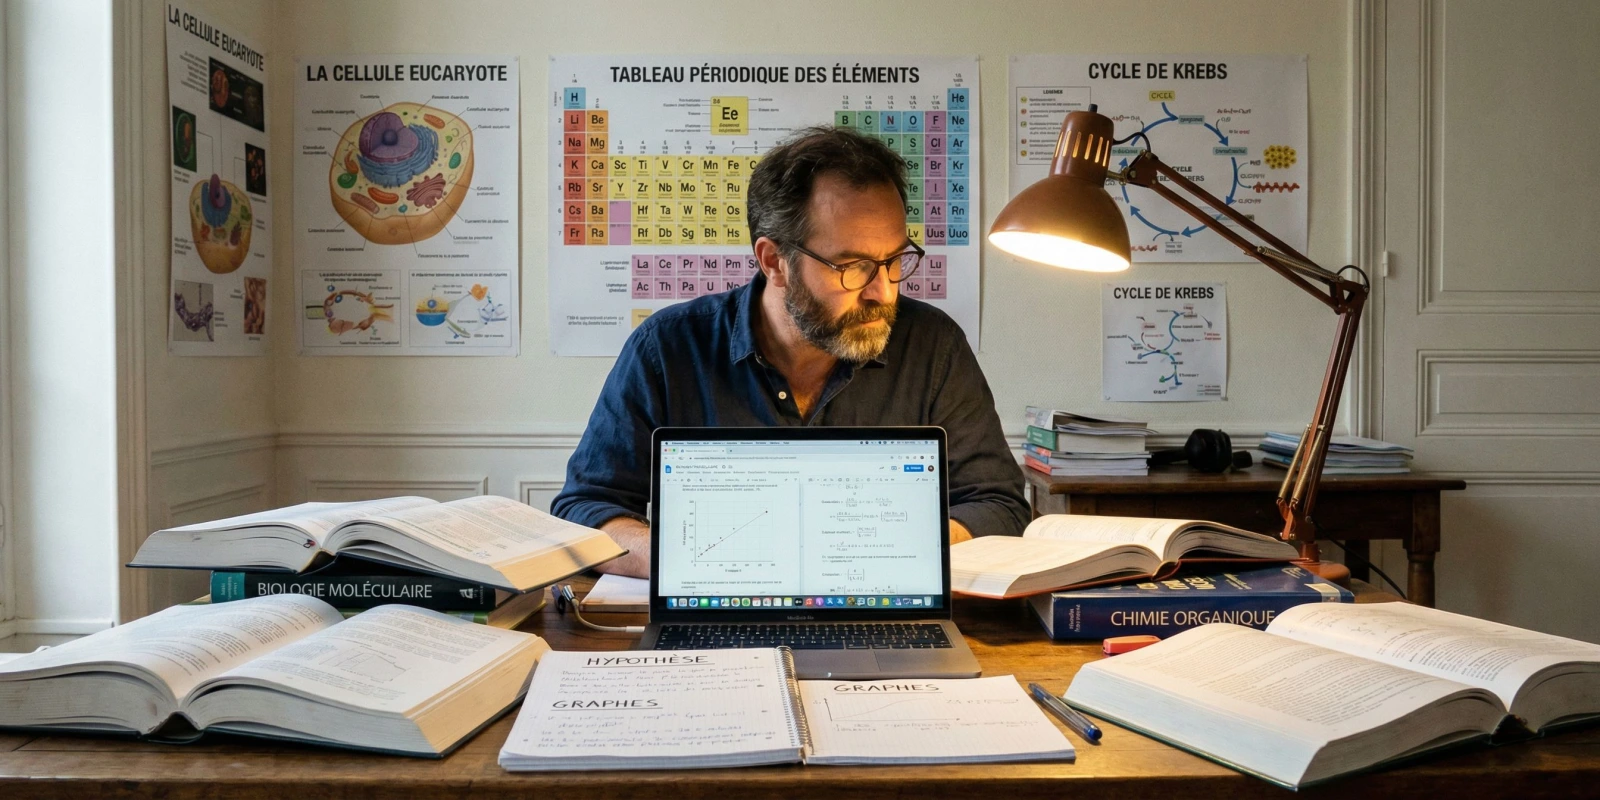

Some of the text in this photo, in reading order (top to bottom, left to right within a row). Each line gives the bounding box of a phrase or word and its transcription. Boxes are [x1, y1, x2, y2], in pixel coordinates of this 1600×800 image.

[169, 4, 264, 72] LA CELLULE EUCARYOTE
[307, 65, 507, 81] LA CELLULE EUCARYOTE
[610, 63, 919, 84] TABLEAU PÉRIODIQUE DES ÉLÉMENTS
[1089, 63, 1227, 79] CYCLE DE KREBS
[571, 93, 964, 103] H He
[722, 107, 738, 120] Ee
[571, 114, 964, 125] Li Be B C N O F Ne
[568, 138, 963, 149] Na Mg P S Cl Ar
[571, 160, 578, 169] K
[591, 160, 604, 169] Ca
[614, 160, 626, 169] Sc
[638, 160, 647, 169] Ti
[662, 160, 668, 169] V
[683, 160, 694, 170] Cr
[704, 160, 718, 169] Mn
[728, 160, 739, 170] Fe
[907, 161, 919, 170] Se
[930, 161, 941, 170] Br
[953, 161, 964, 170] Kr
[568, 182, 581, 192] Rb
[593, 182, 603, 192] Sr
[617, 183, 623, 192] Y
[638, 183, 648, 192] Zr
[659, 183, 672, 192] Nb
[681, 183, 695, 192] Mo
[705, 183, 716, 192] Tc
[727, 183, 740, 192] Ru
[908, 183, 918, 193] Te
[952, 183, 964, 192] Xe
[569, 205, 964, 215] Cs Ba Hf Ta W Re Os Po At Rn
[570, 228, 968, 240] Fr Ra Rf Db Sg Bh Hs Lv Uus Uuo
[637, 259, 648, 269] La
[659, 259, 671, 269] Ce
[683, 259, 693, 268] Pr
[704, 259, 717, 268] Nd
[726, 259, 741, 268] Pm
[930, 259, 941, 269] Lu
[636, 282, 649, 291] Ac
[659, 282, 671, 291] Th
[682, 282, 694, 291] Pa
[707, 282, 714, 291] U
[906, 282, 920, 291] No
[931, 282, 941, 291] Lr
[1114, 287, 1214, 299] CYCLE DE KREBS
[257, 581, 432, 598] BIOLOGIE MOLÉCULAIRE
[1111, 610, 1276, 627] CHIMIE ORGANIQUE
[587, 654, 708, 666] HYPOTHÈSE
[834, 684, 939, 692] GRAPHES
[552, 699, 659, 708] GRAPHES
